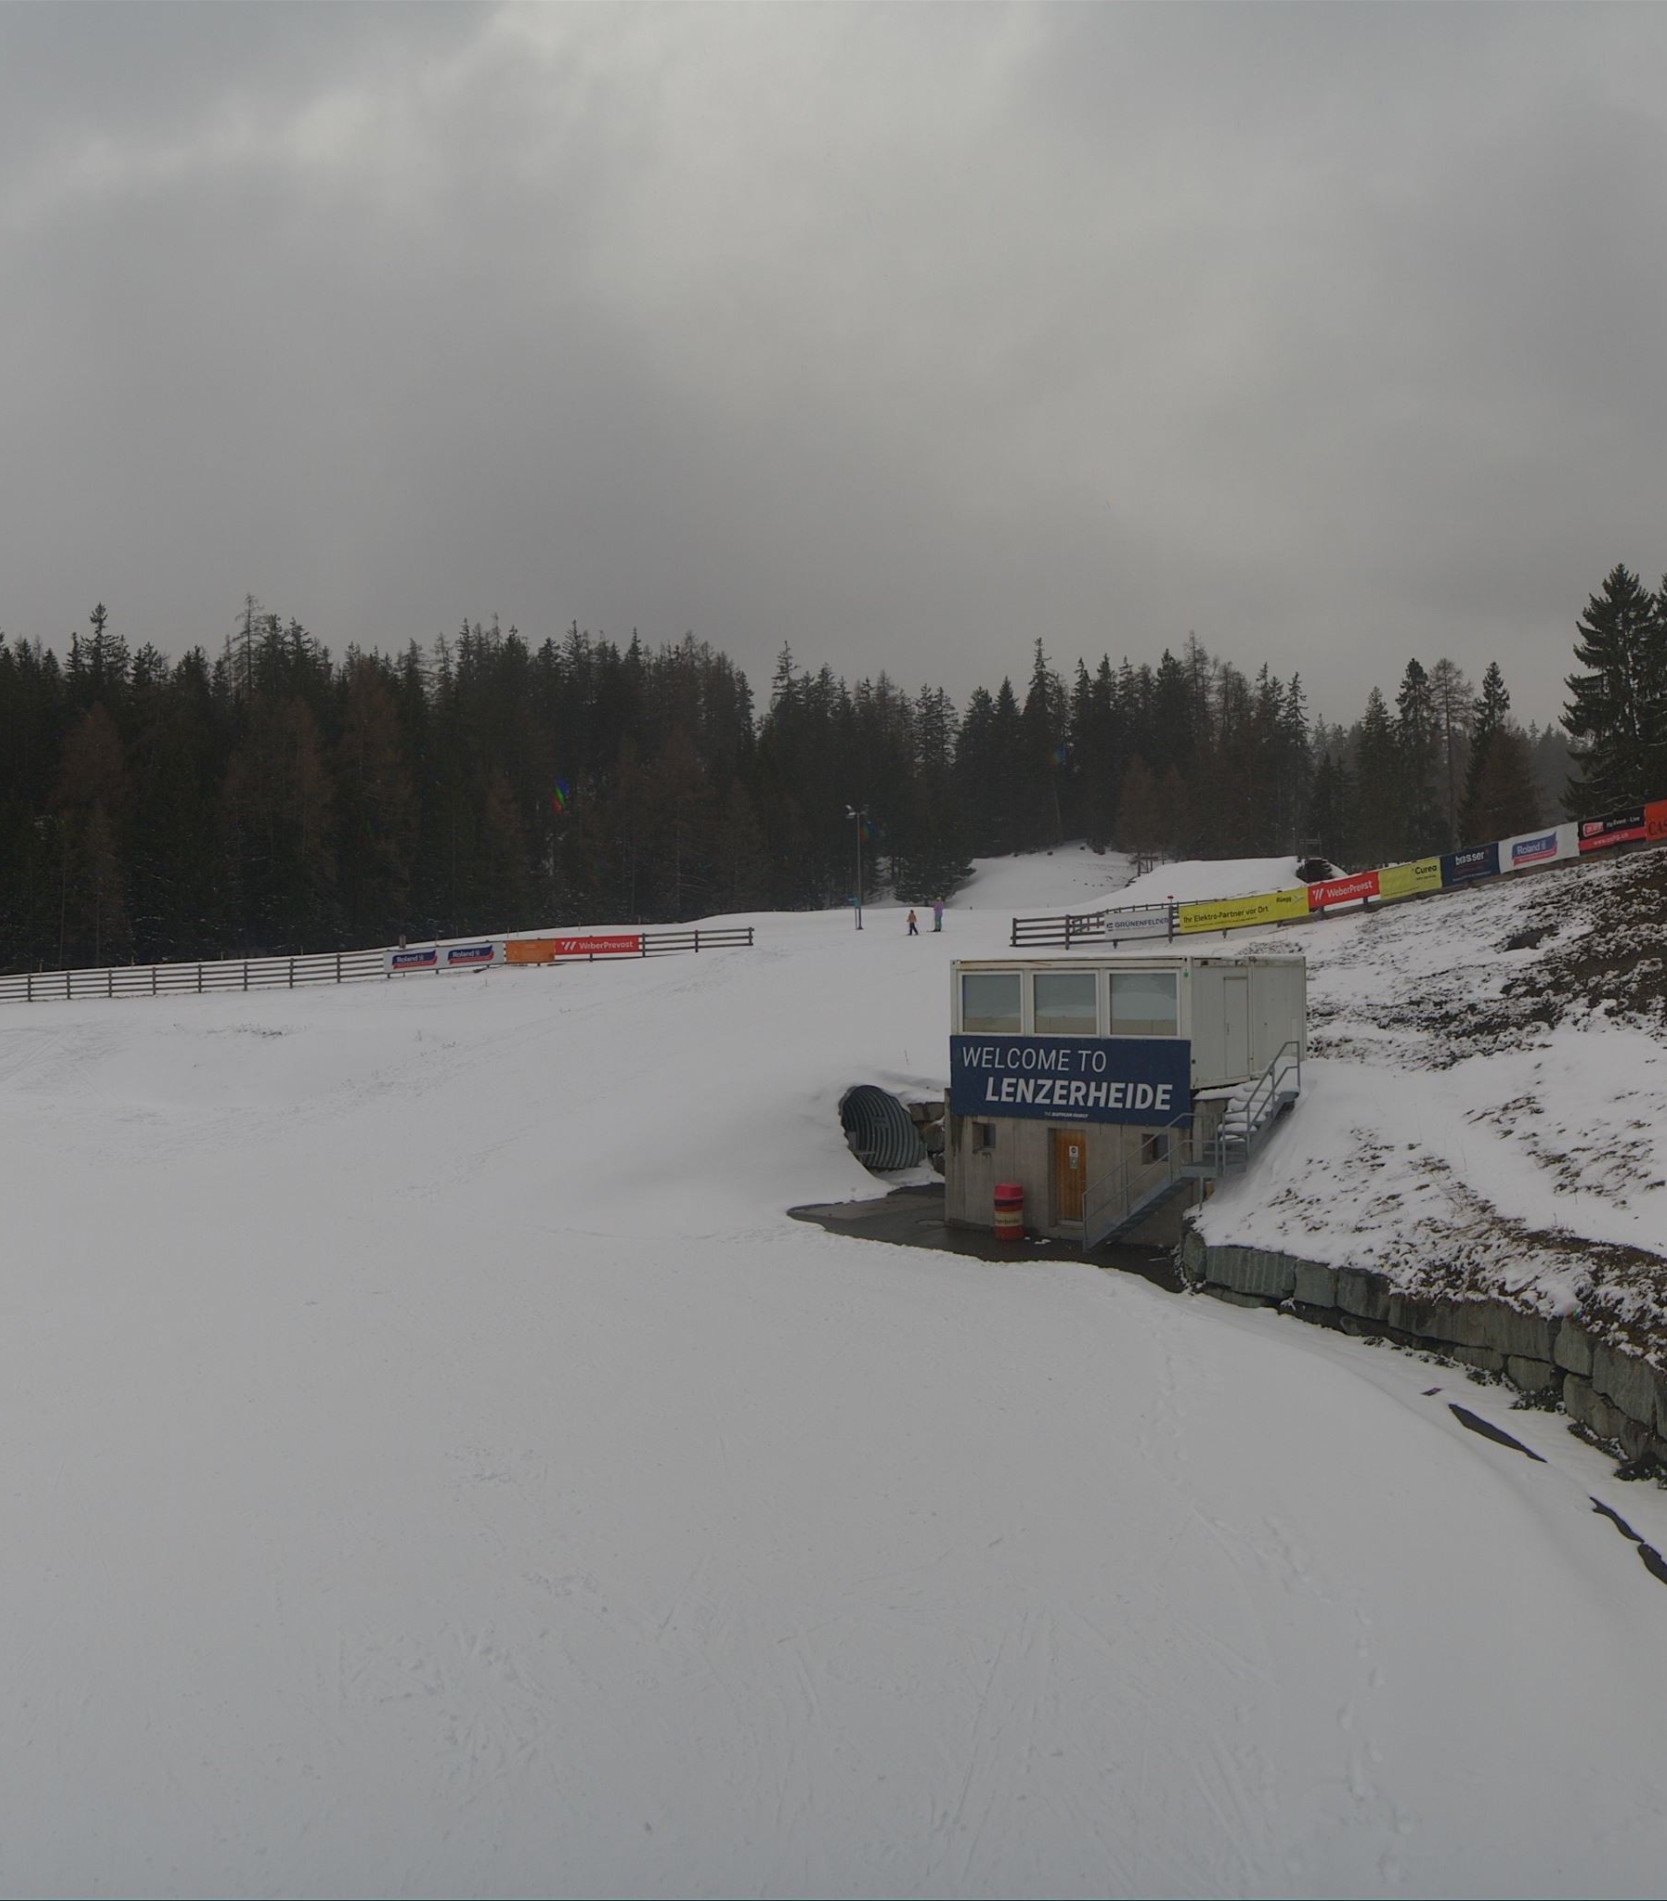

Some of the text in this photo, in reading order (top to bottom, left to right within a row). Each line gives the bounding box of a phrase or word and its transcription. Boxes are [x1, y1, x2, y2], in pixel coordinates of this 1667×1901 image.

[1517, 842, 1541, 854] Roland
[1194, 910, 1243, 924] Elektro-Partner
[1257, 906, 1268, 914] Ort
[962, 1046, 1107, 1073] WELCOME TO
[985, 1077, 1173, 1110] LENZERHEIDE
